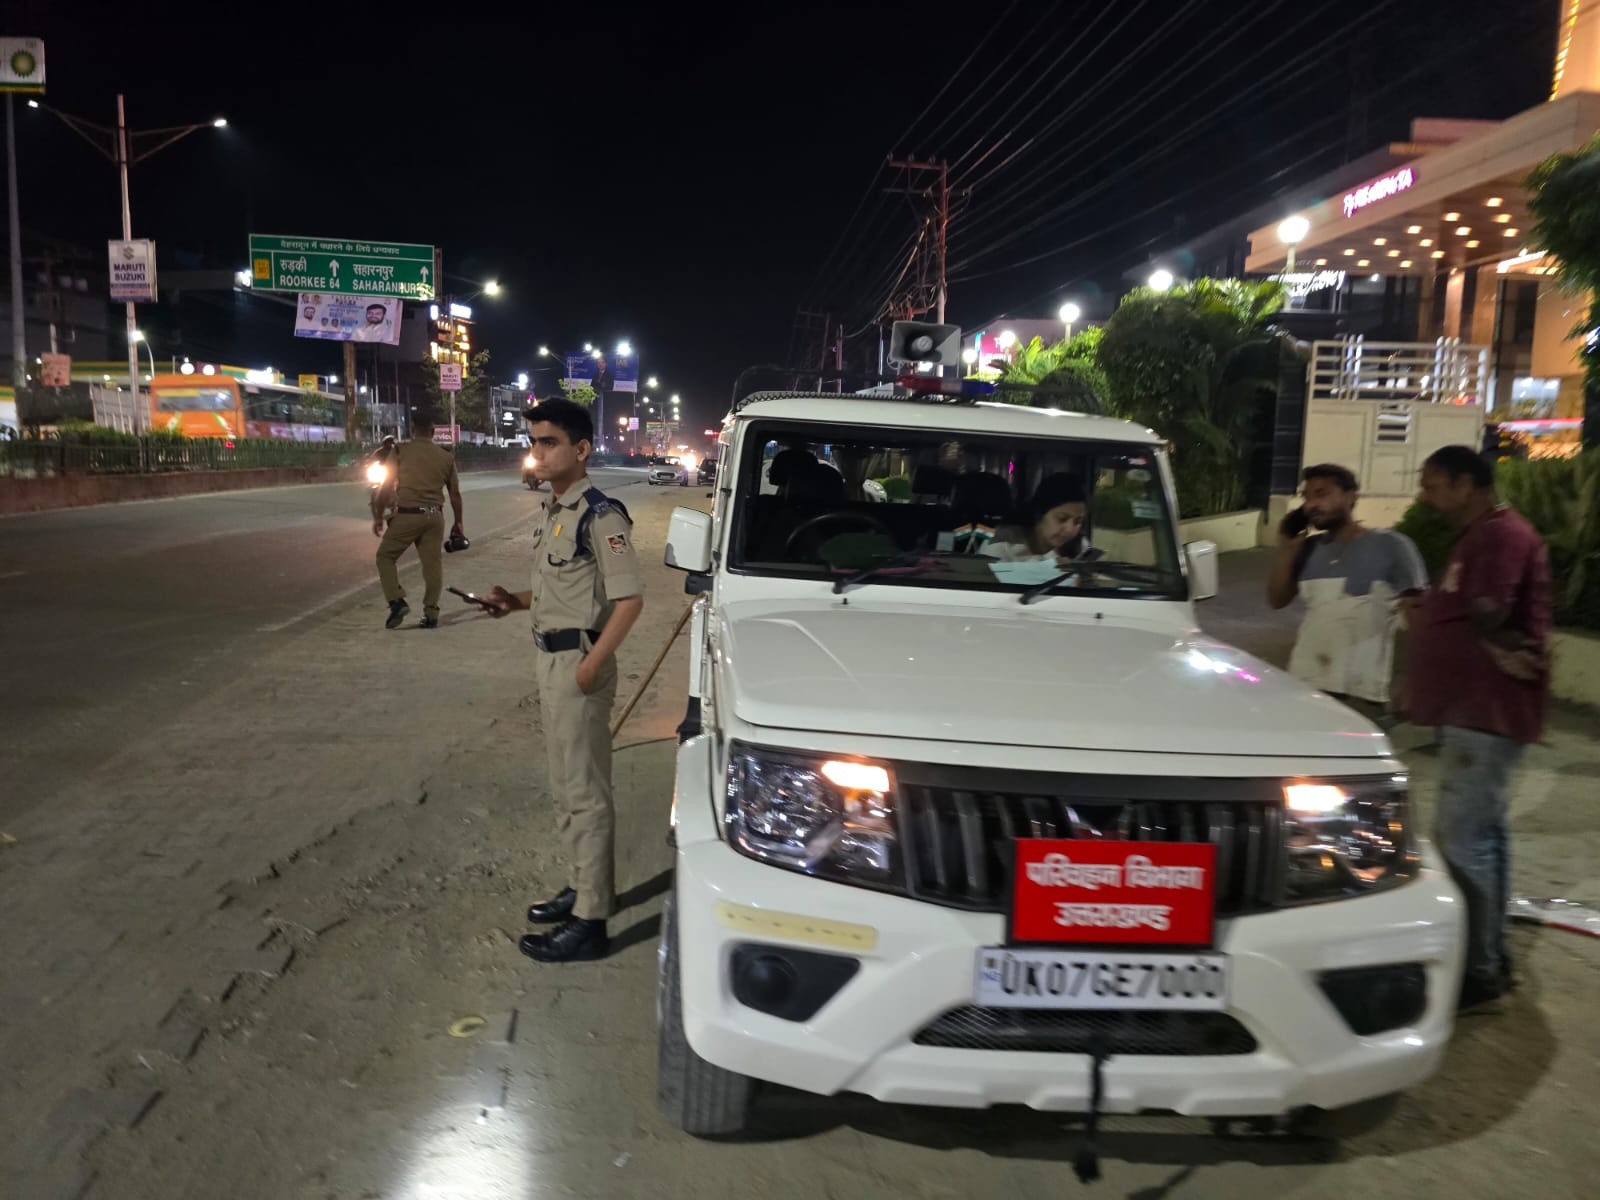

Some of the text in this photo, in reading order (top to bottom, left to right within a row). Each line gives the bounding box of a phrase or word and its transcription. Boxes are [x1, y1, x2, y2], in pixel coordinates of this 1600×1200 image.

[113, 263, 146, 272] MARUTI
[114, 272, 146, 281] SUZUKI
[280, 257, 307, 272] रुड़की
[353, 263, 394, 280] सहारनपुर
[280, 275, 326, 289] ROORKEE
[352, 279, 416, 295] SAHARANPUR
[1025, 853, 1206, 890] परिवहन विभाग
[1001, 955, 1223, 998] UK07GE7000
